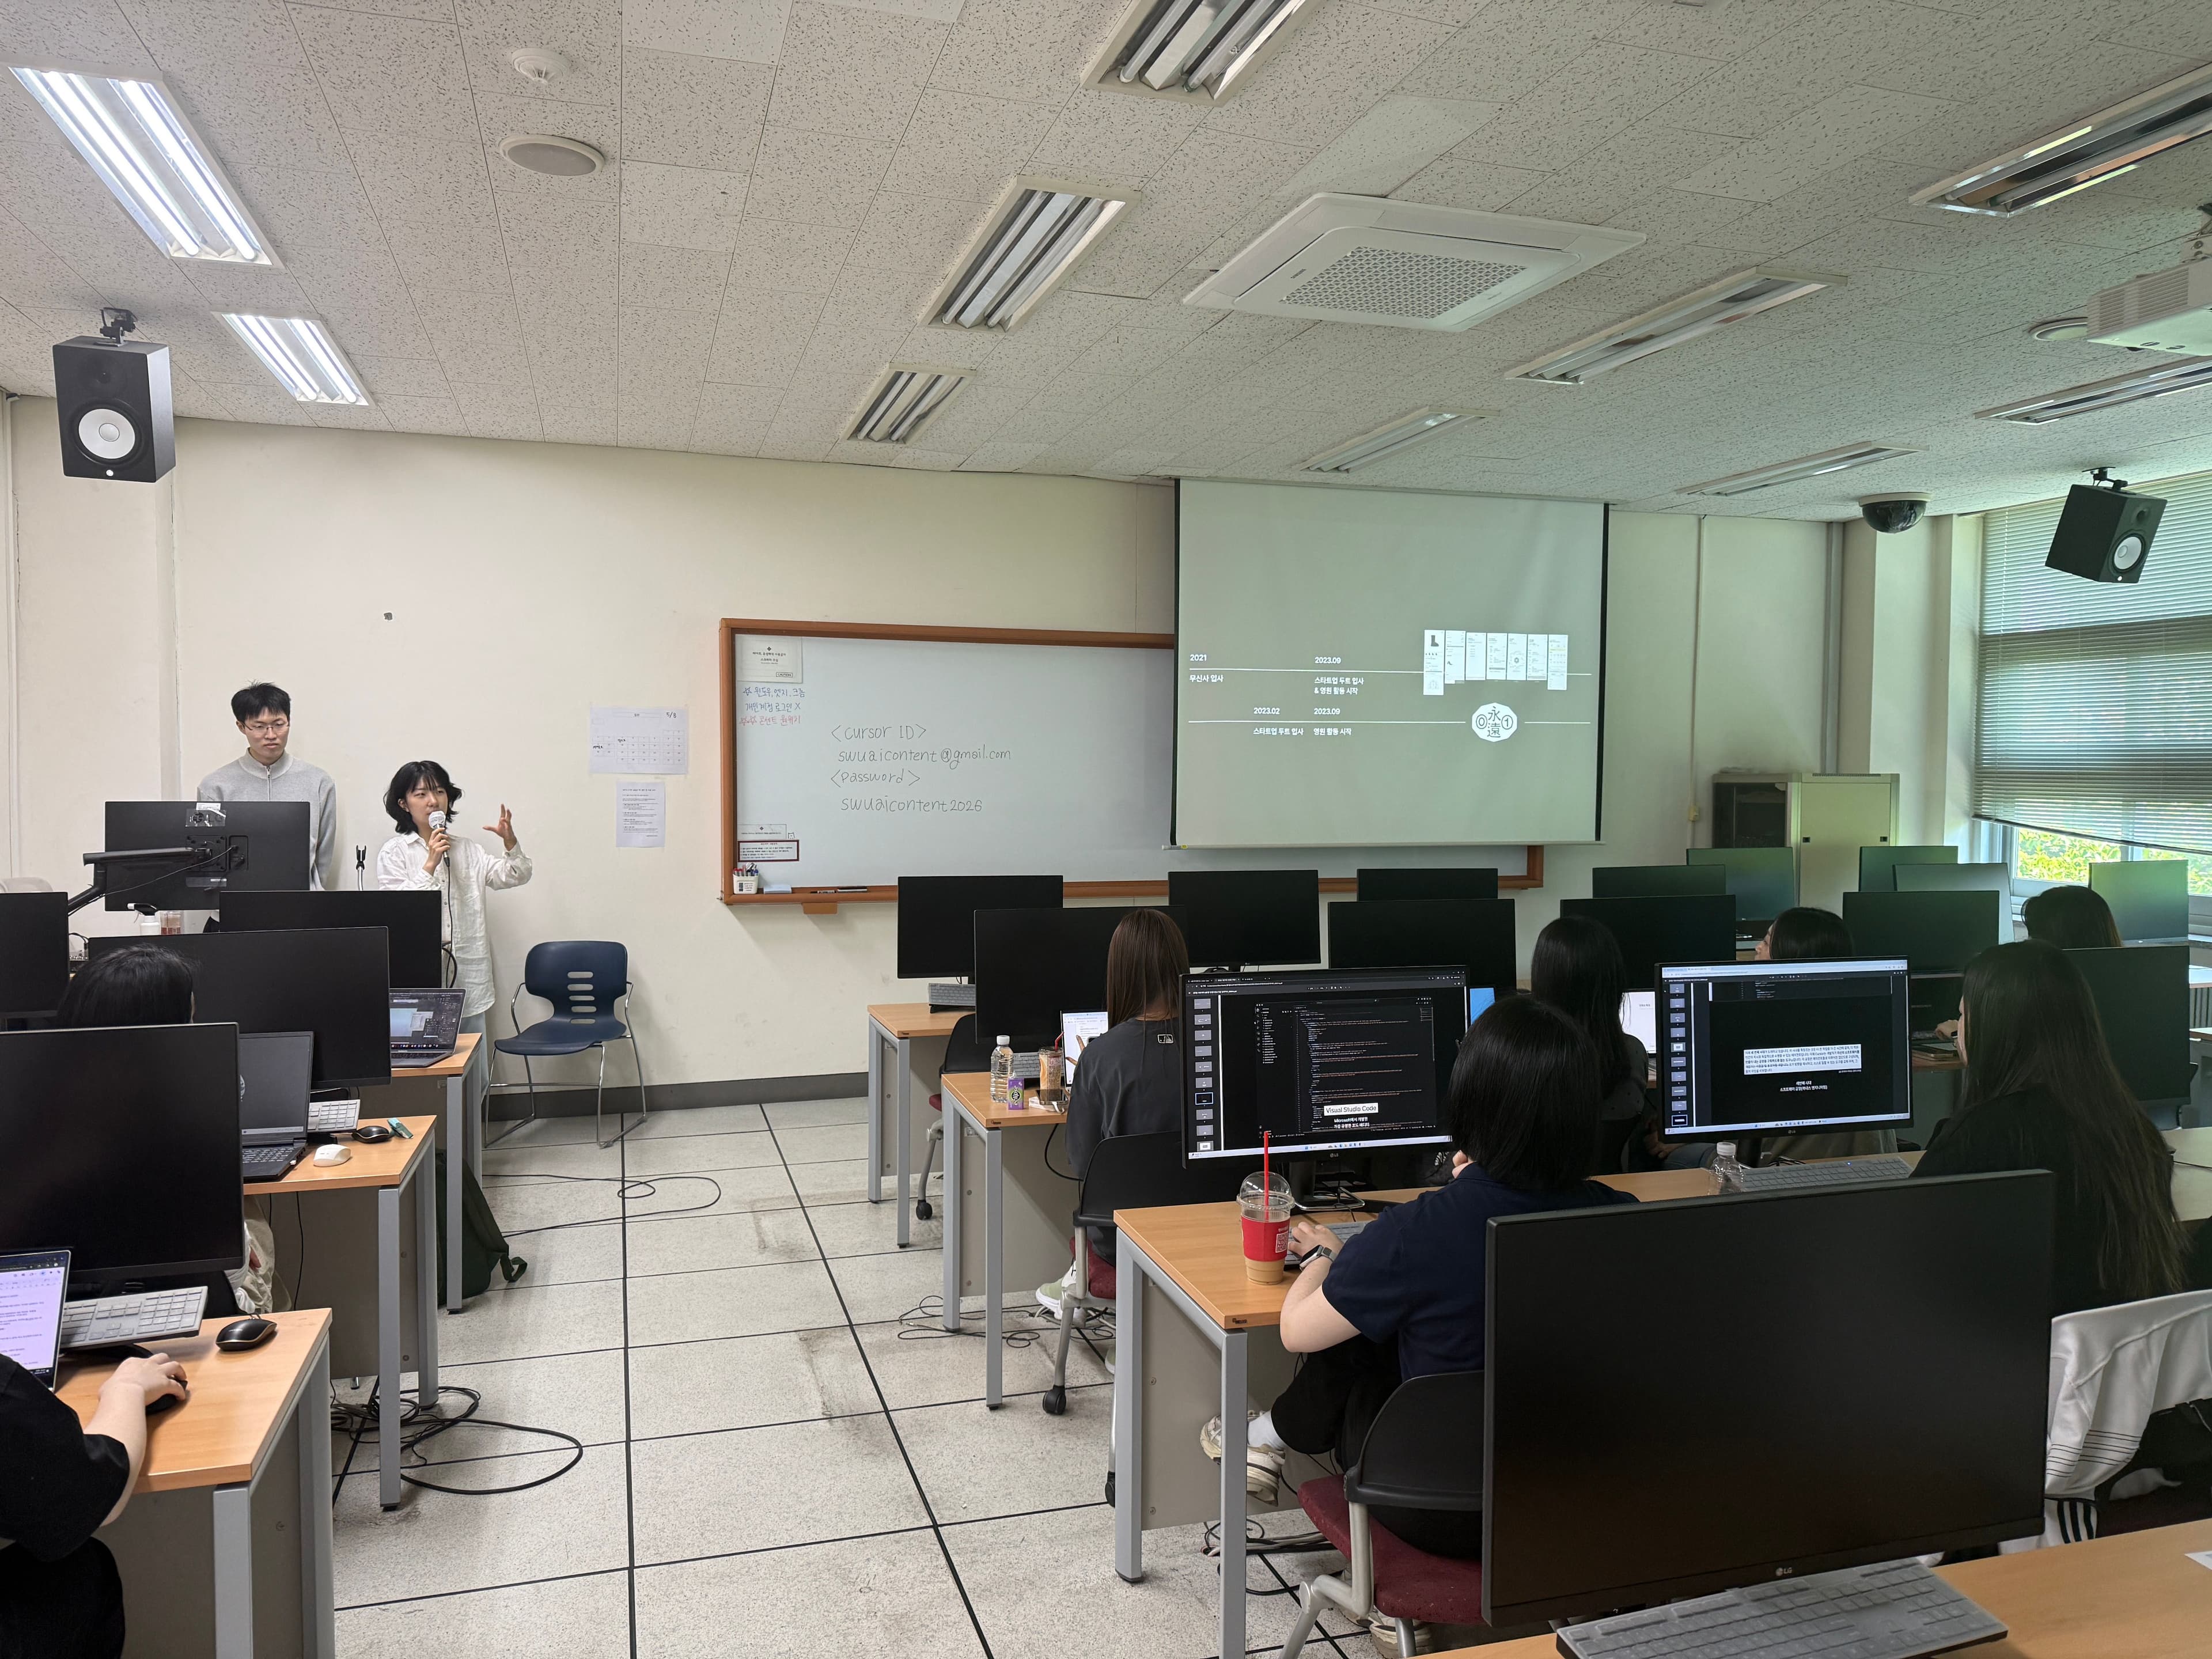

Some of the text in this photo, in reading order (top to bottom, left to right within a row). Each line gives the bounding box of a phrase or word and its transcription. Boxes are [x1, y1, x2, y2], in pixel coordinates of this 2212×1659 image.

[1190, 674, 1224, 682] 무신사 입사
[1314, 676, 1338, 684] 스타트업
[1352, 677, 1364, 685] 입사
[1320, 687, 1332, 695] 영원
[1334, 687, 1345, 695] 활동
[745, 702, 773, 713] 개인계정
[775, 703, 791, 713] 로그인
[841, 795, 982, 812] swuaicontent2026
